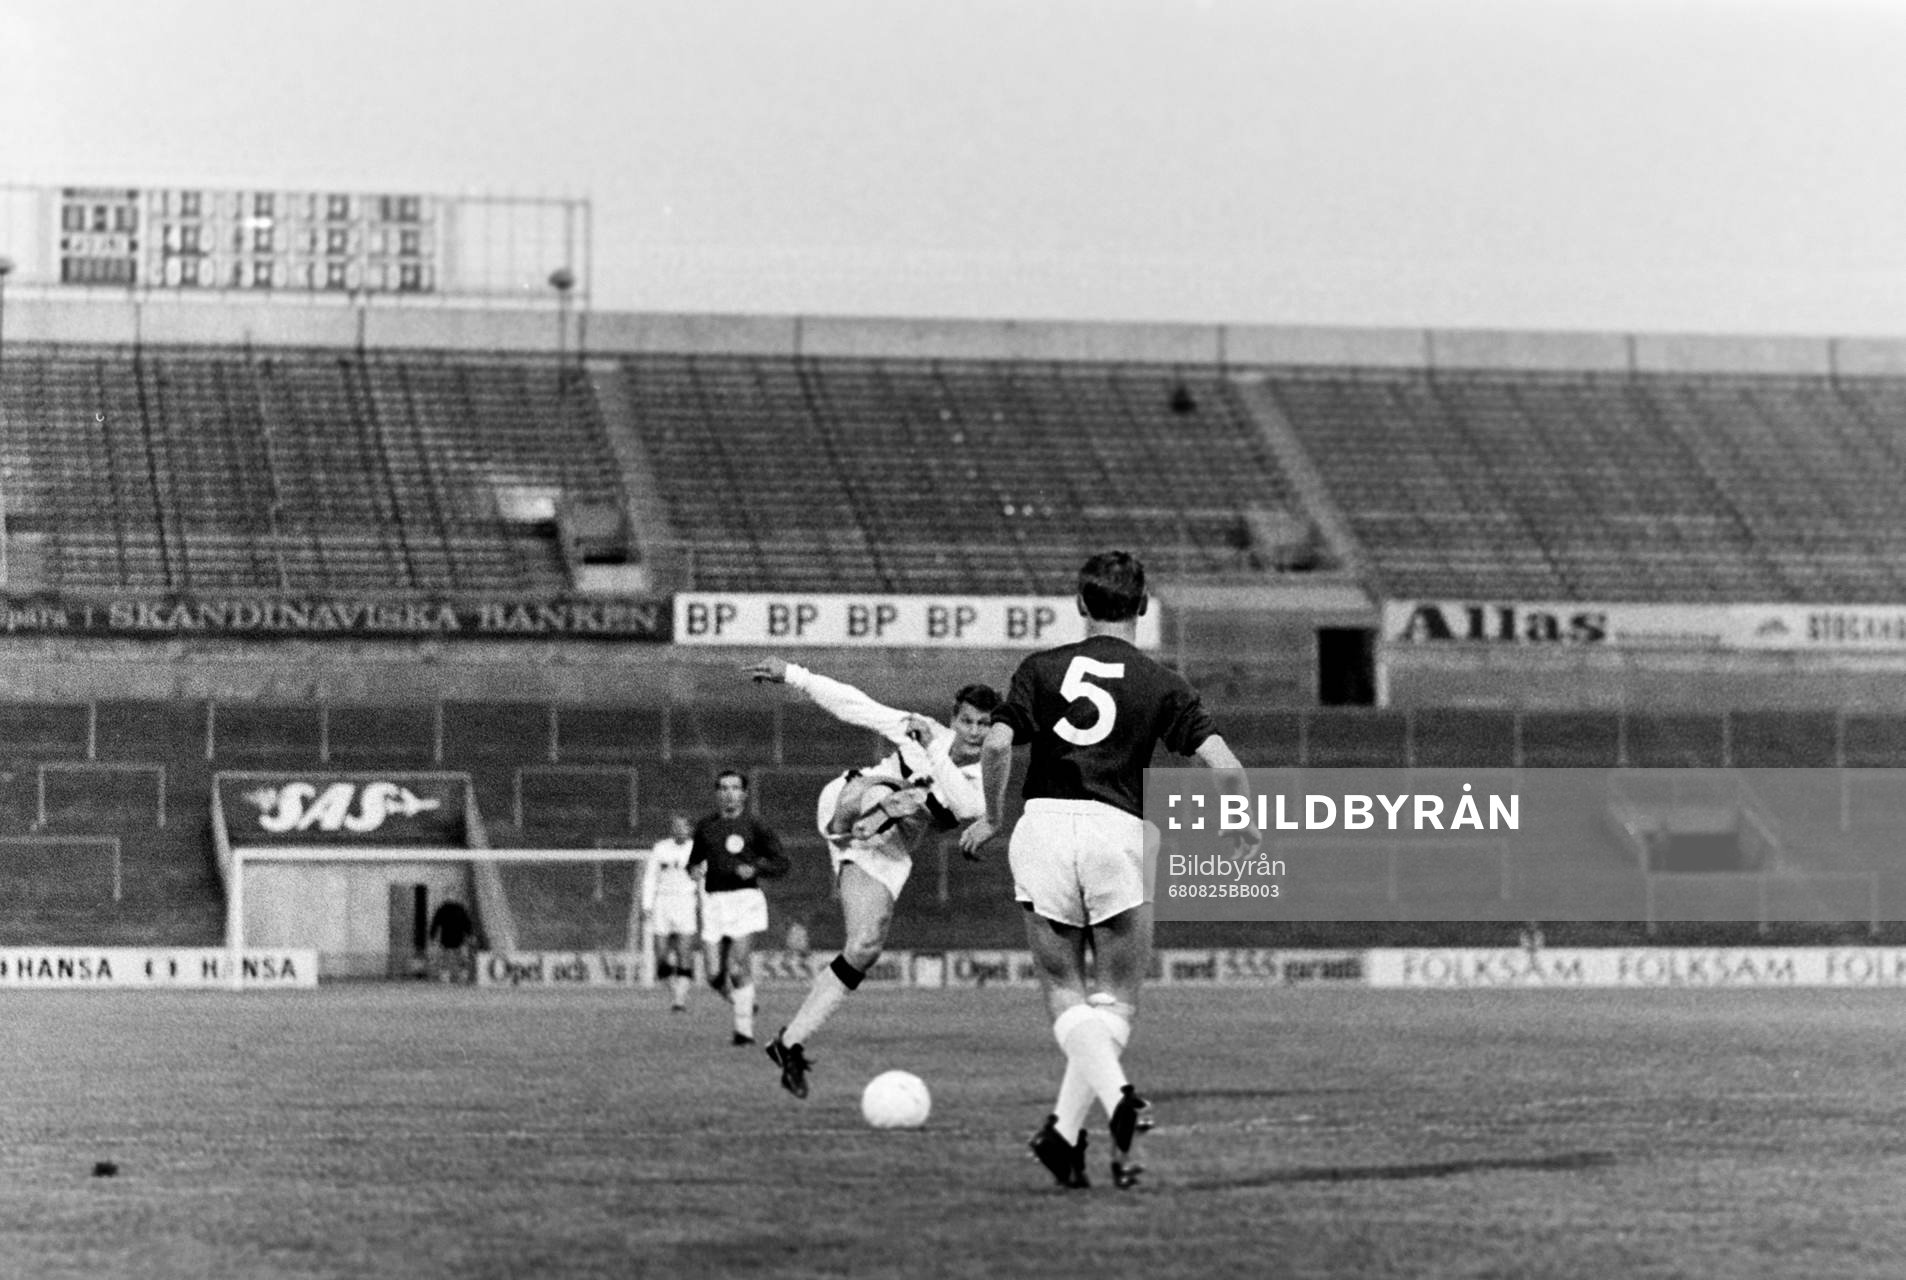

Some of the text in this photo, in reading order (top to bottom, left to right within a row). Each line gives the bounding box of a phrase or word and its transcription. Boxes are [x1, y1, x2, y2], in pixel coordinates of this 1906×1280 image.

[109, 602, 657, 631] SKANDINAVISKA BANKEN
[687, 603, 1055, 640] BP BP BP BP BP
[1402, 606, 1606, 641] Allas
[1053, 656, 1125, 746] 5
[259, 782, 399, 832] SAS
[18, 957, 113, 978] HANSA
[1403, 956, 1583, 982] FOLKSAM
[1617, 956, 1796, 982] FOLKSAM
